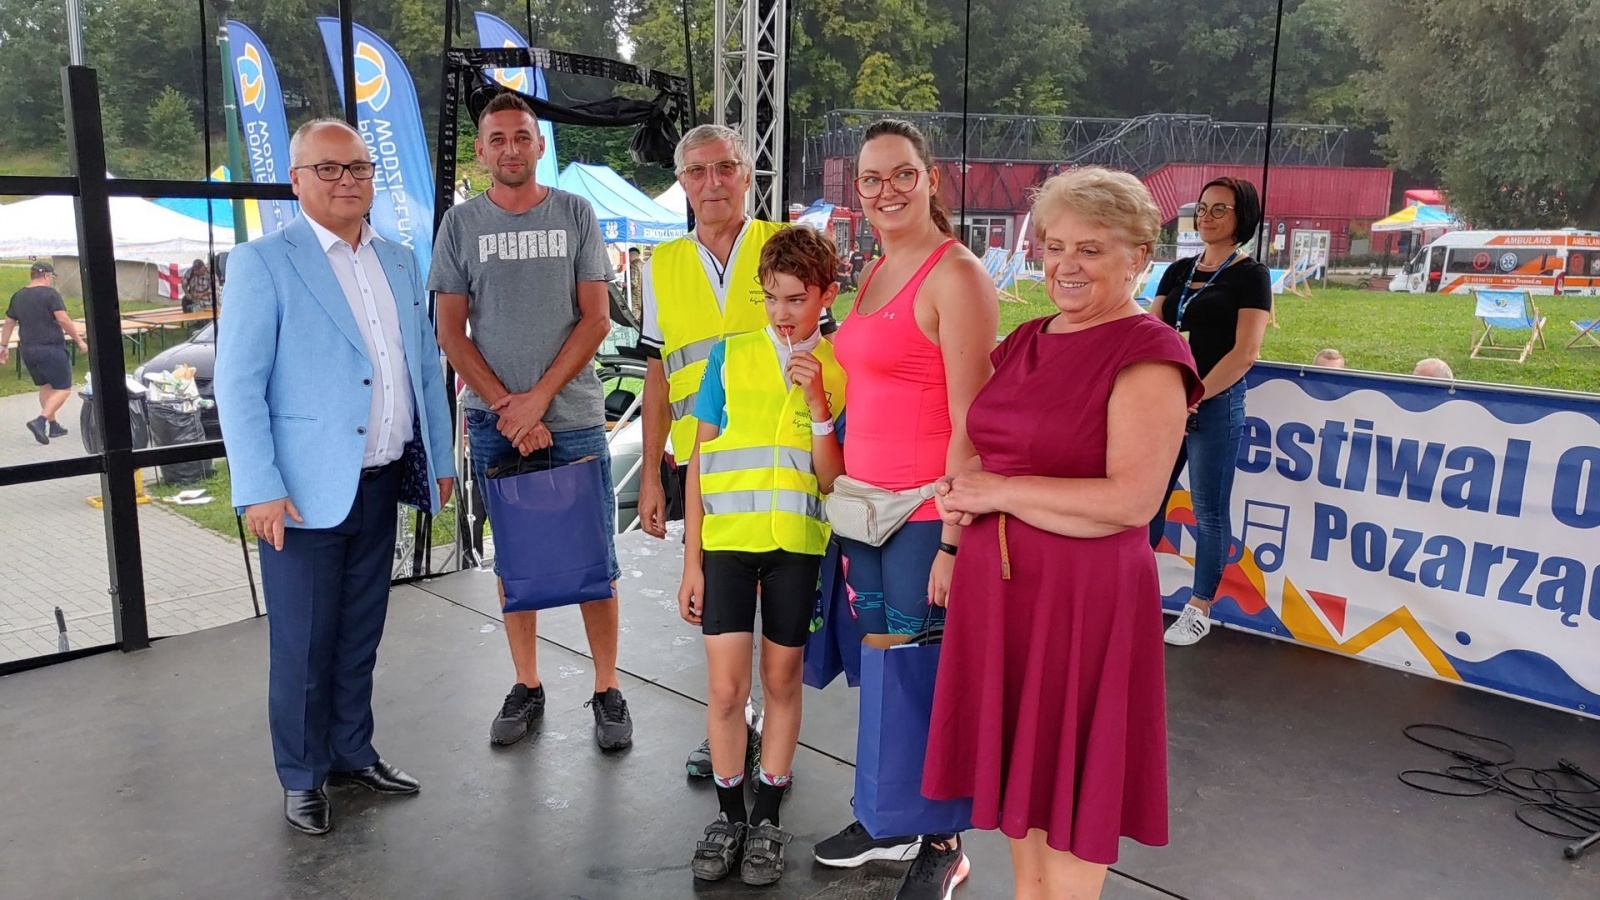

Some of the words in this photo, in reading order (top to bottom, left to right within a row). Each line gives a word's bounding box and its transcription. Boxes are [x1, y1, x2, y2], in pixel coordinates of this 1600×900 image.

[478, 229, 567, 263] PUMA
[1504, 236, 1552, 245] AMBULANS
[1235, 415, 1532, 518] estiwal
[1310, 501, 1600, 628] Pozarzą
